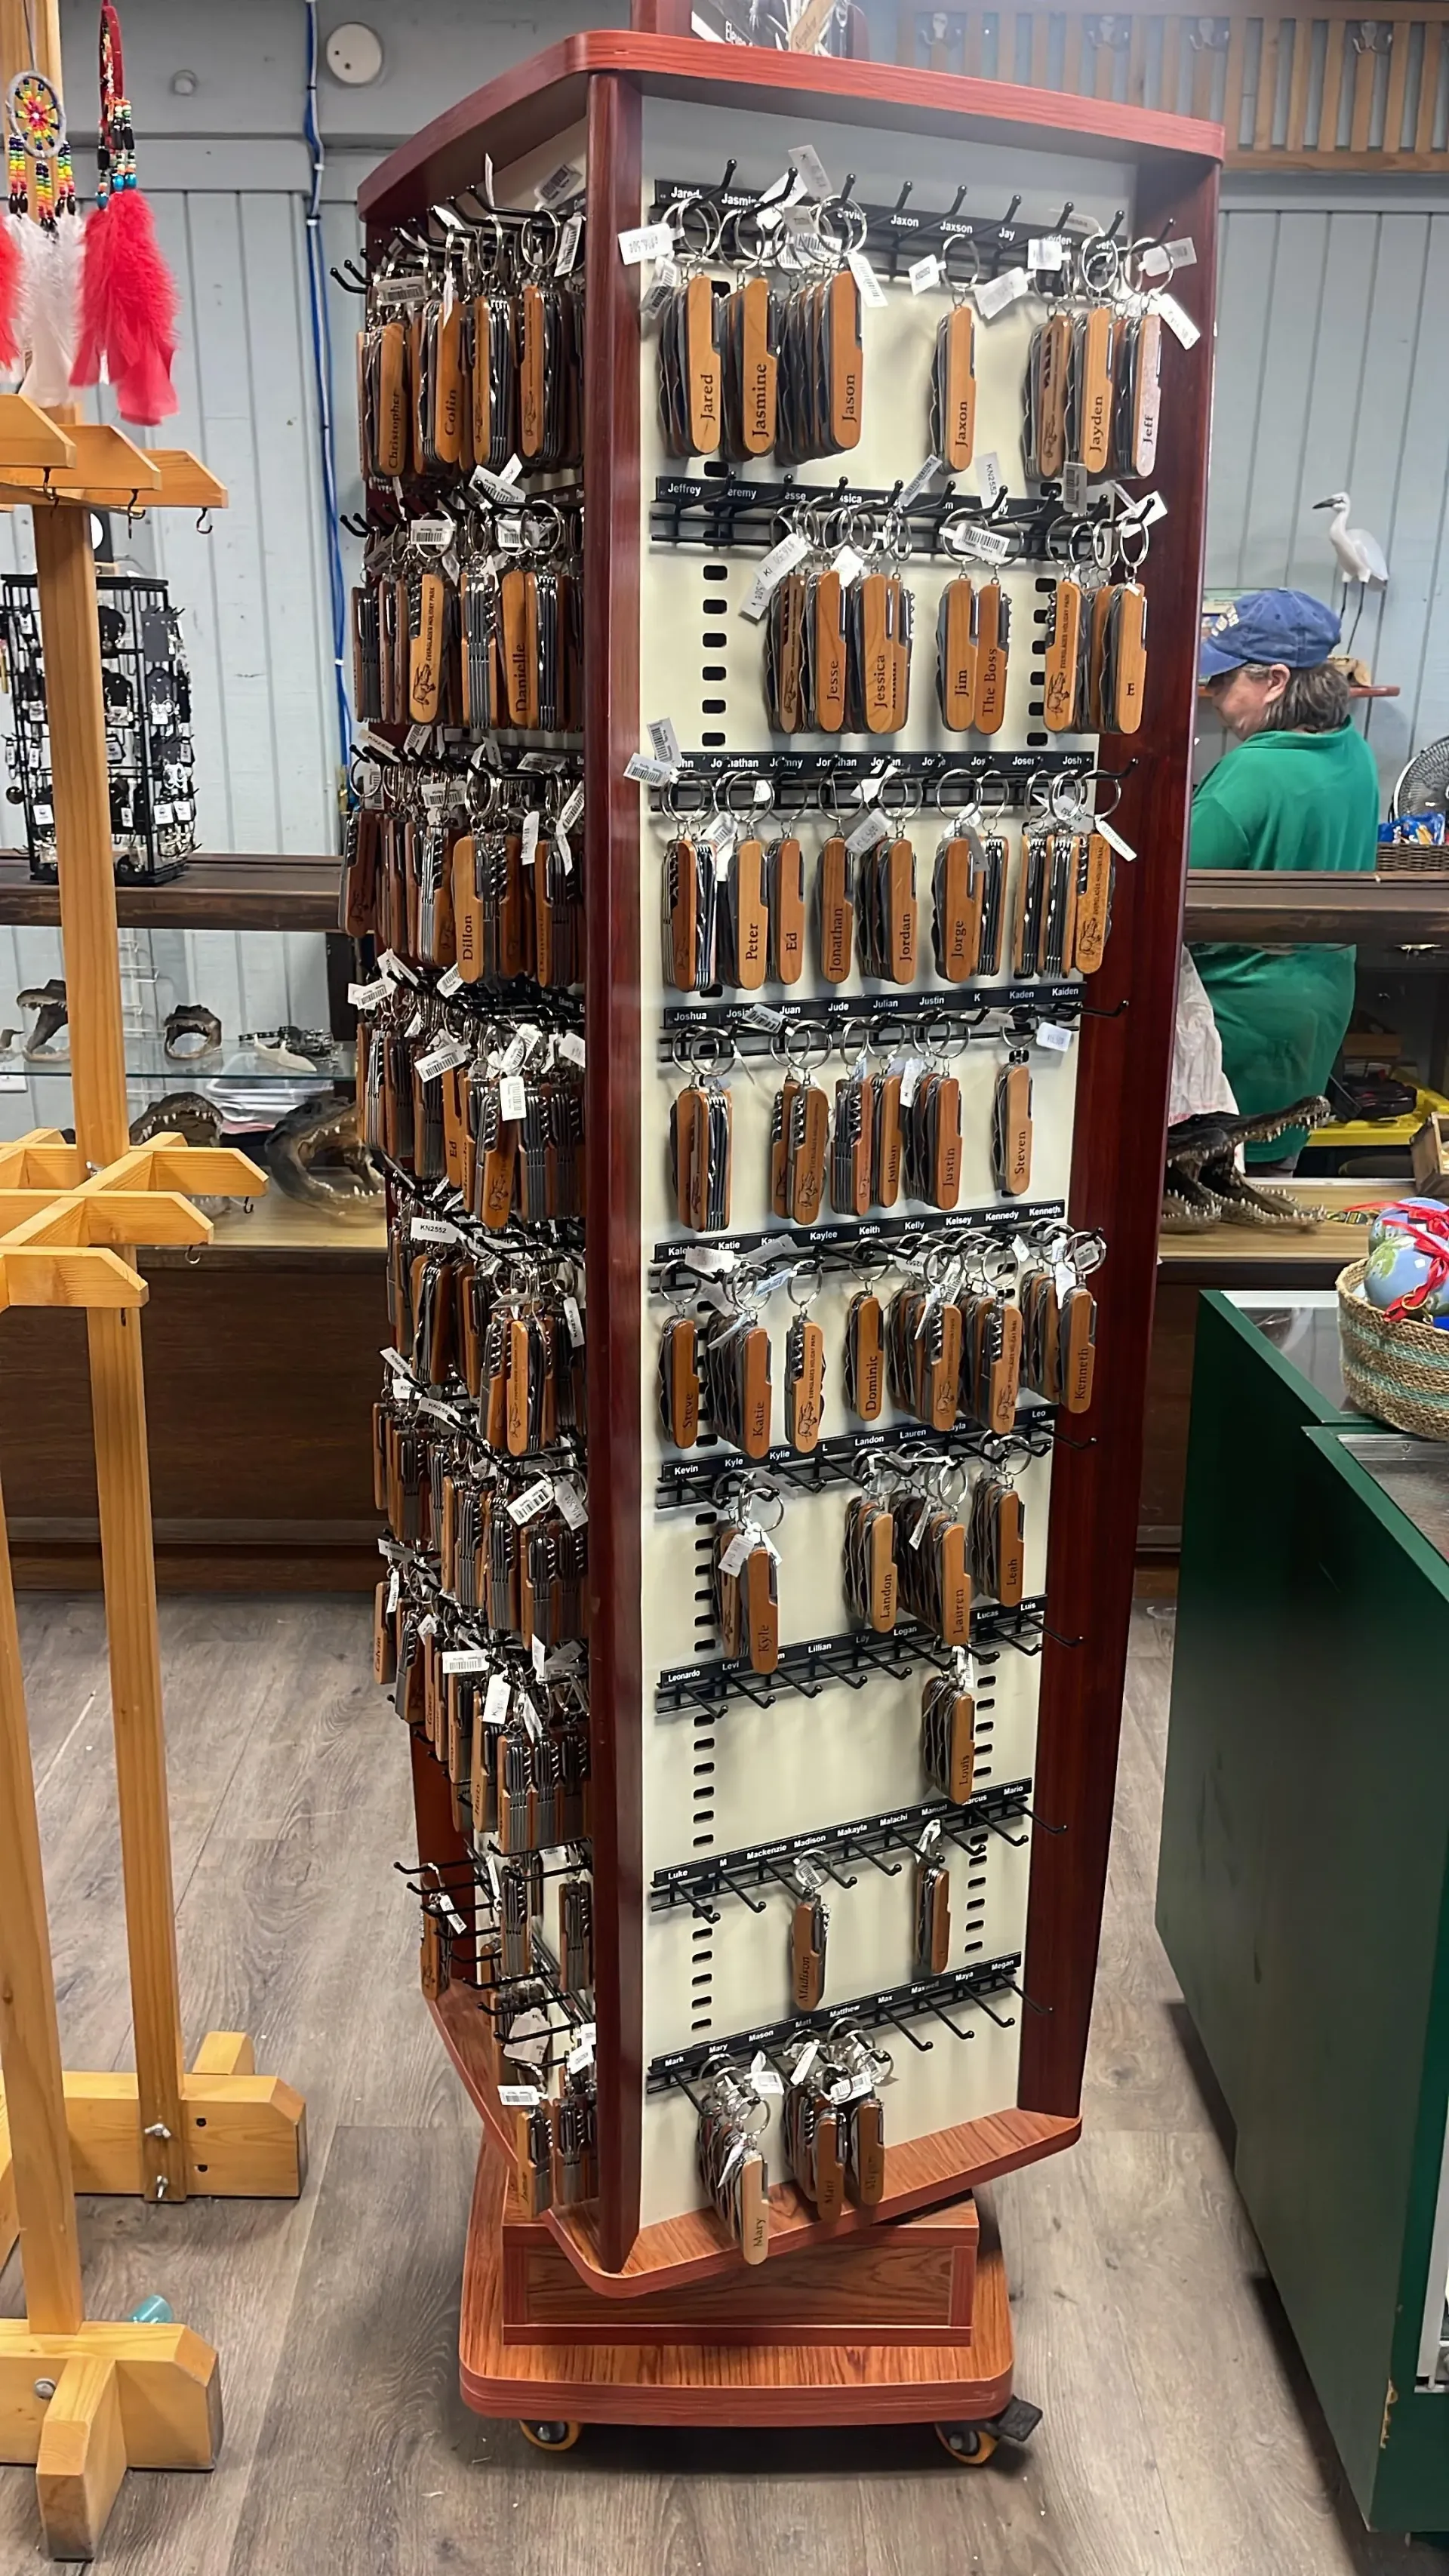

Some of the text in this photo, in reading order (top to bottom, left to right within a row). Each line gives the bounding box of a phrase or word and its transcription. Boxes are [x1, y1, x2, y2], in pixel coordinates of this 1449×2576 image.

[891, 215, 919, 227] Jaxon
[940, 221, 973, 234] Jaxson
[999, 227, 1015, 241] Jay
[445, 389, 457, 435] Colin
[700, 374, 715, 420] Jared
[752, 363, 770, 437] Jasmine
[842, 374, 857, 422] Jason
[955, 401, 968, 448] Jaxon
[1090, 395, 1104, 452] Jayden
[1143, 414, 1154, 444] Jeff
[667, 483, 701, 497] Jeffrey
[727, 488, 756, 500] eremy
[785, 492, 806, 501] esse
[986, 464, 998, 496] KN2552
[426, 627, 434, 661] EVERGLADES
[512, 643, 527, 712] Danielle
[826, 660, 840, 702] Jesse
[874, 654, 888, 709] Jessica
[955, 669, 969, 697] Jim
[982, 648, 997, 716] The Boss
[1127, 682, 1135, 696] E
[710, 757, 758, 768] Jonathan
[770, 757, 802, 769] Jonny
[817, 756, 857, 768] Jonthan
[1062, 756, 1082, 765] Josh
[463, 916, 473, 961] Dillon
[746, 922, 758, 961] Peter
[786, 932, 797, 952] Ed
[830, 907, 843, 972] Jonathan
[900, 913, 912, 962] Jordan
[951, 919, 967, 959] Jorge
[674, 1011, 707, 1021] Joshua
[779, 1005, 801, 1015] Juan
[828, 1002, 849, 1011] Jude
[873, 999, 898, 1008] Julian
[919, 996, 944, 1005] Justin
[974, 993, 980, 1002] K
[1009, 990, 1034, 999] Kaden
[1051, 986, 1078, 996] Kaiden
[449, 1140, 457, 1158] Ed
[888, 1145, 897, 1184] Julian
[943, 1147, 955, 1187] Justin
[1014, 1131, 1026, 1174] Steven
[419, 1223, 447, 1235] KN2552
[718, 1241, 740, 1251] Katie
[810, 1231, 838, 1241] Kaylee
[859, 1226, 881, 1235] Keith
[905, 1221, 924, 1231] Kelly
[946, 1216, 972, 1226] Kelsey
[986, 1211, 1019, 1222] Kennedy
[1029, 1206, 1061, 1217] Kenneth
[866, 1356, 878, 1411] Dominic
[1074, 1348, 1089, 1401] Kenneth
[683, 1393, 693, 1428] Steve
[753, 1402, 764, 1437] Katie
[675, 1465, 698, 1476] Kevin
[724, 1457, 743, 1467] Kyle
[770, 1451, 790, 1460] Kylie
[855, 1436, 884, 1446] Landon
[900, 1428, 927, 1439] Lauren
[949, 1422, 966, 1431] ayla
[1007, 1558, 1018, 1586] Leah
[880, 1574, 892, 1618] Landon
[953, 1588, 964, 1634] Lauren
[668, 1669, 700, 1682] Leonardo
[722, 1661, 740, 1670] Levi
[808, 1642, 832, 1653] Lillian
[894, 1626, 917, 1636] Logan
[977, 1609, 998, 1619] Lucas
[1020, 1602, 1035, 1611] Luis
[758, 1623, 773, 1652] Kyle
[668, 1785, 1023, 1880] Luke M Mackenzie Madison Makayla Malachi Manuel arcus Mario
[798, 1956, 810, 2002] Madison
[664, 2056, 685, 2067] Mark
[709, 2043, 728, 2054] Mary
[749, 2029, 774, 2042] Mason
[829, 2004, 860, 2018] Matthew
[878, 1994, 893, 2004] Max
[911, 1980, 939, 1995] Maxwell
[955, 1971, 974, 1981] Maya
[991, 1959, 1014, 1971] Megan
[754, 2218, 766, 2247] Mary
